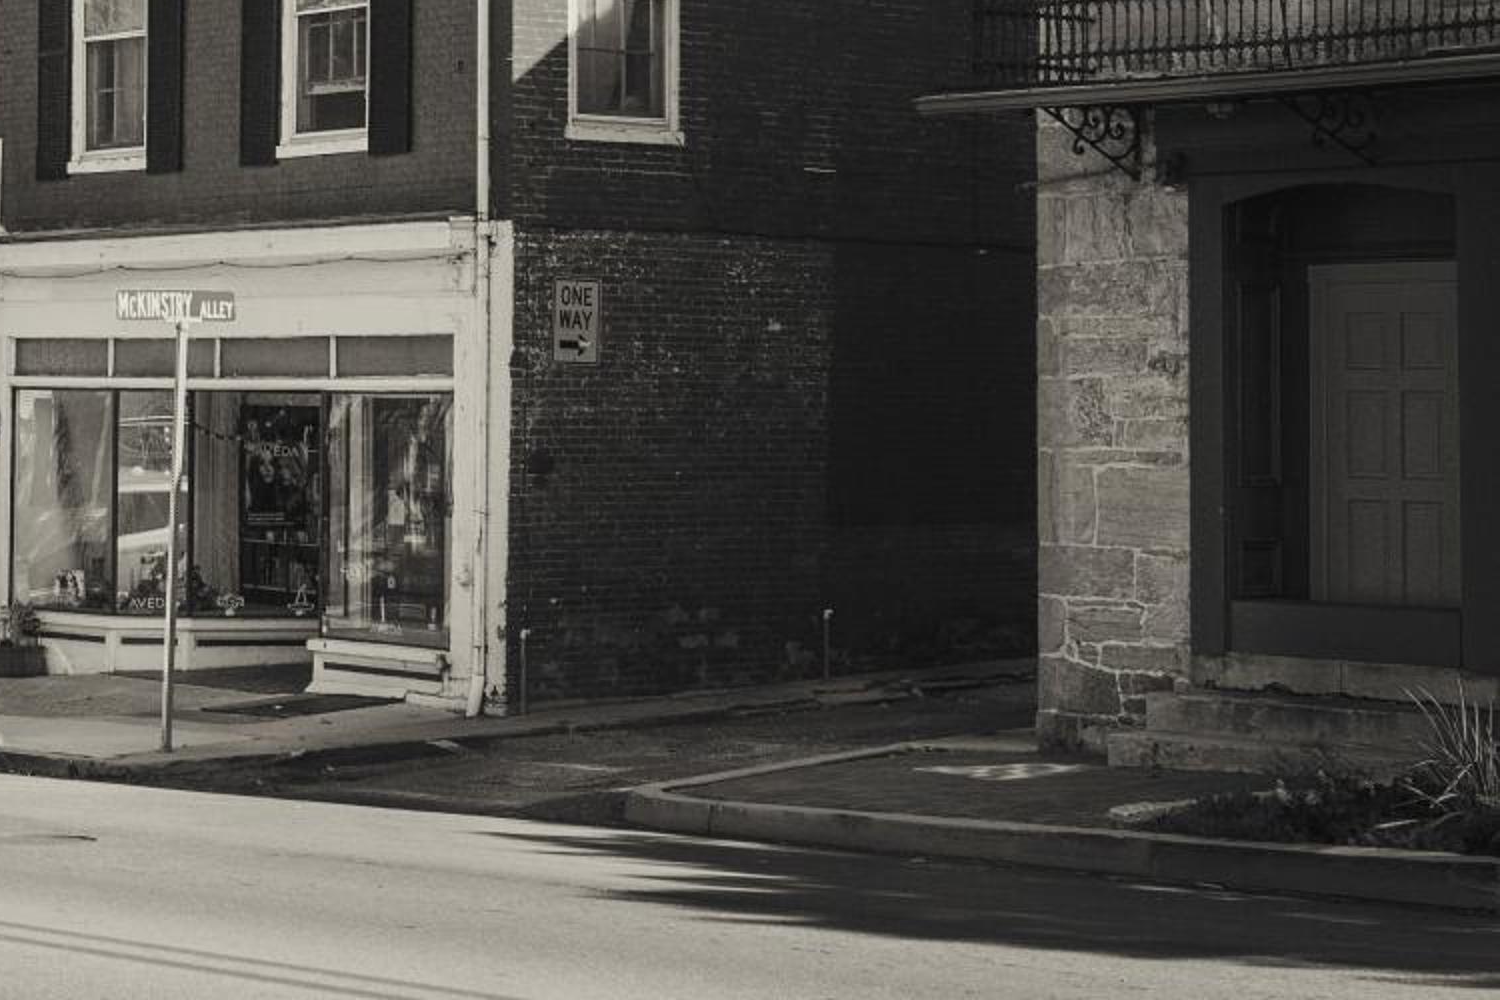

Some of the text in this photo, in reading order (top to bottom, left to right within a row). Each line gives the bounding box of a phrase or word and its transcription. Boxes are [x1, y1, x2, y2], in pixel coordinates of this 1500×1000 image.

[561, 286, 593, 307] ONE
[200, 301, 233, 319] ALLEY
[559, 310, 593, 330] WAY
[130, 597, 166, 609] AVED
